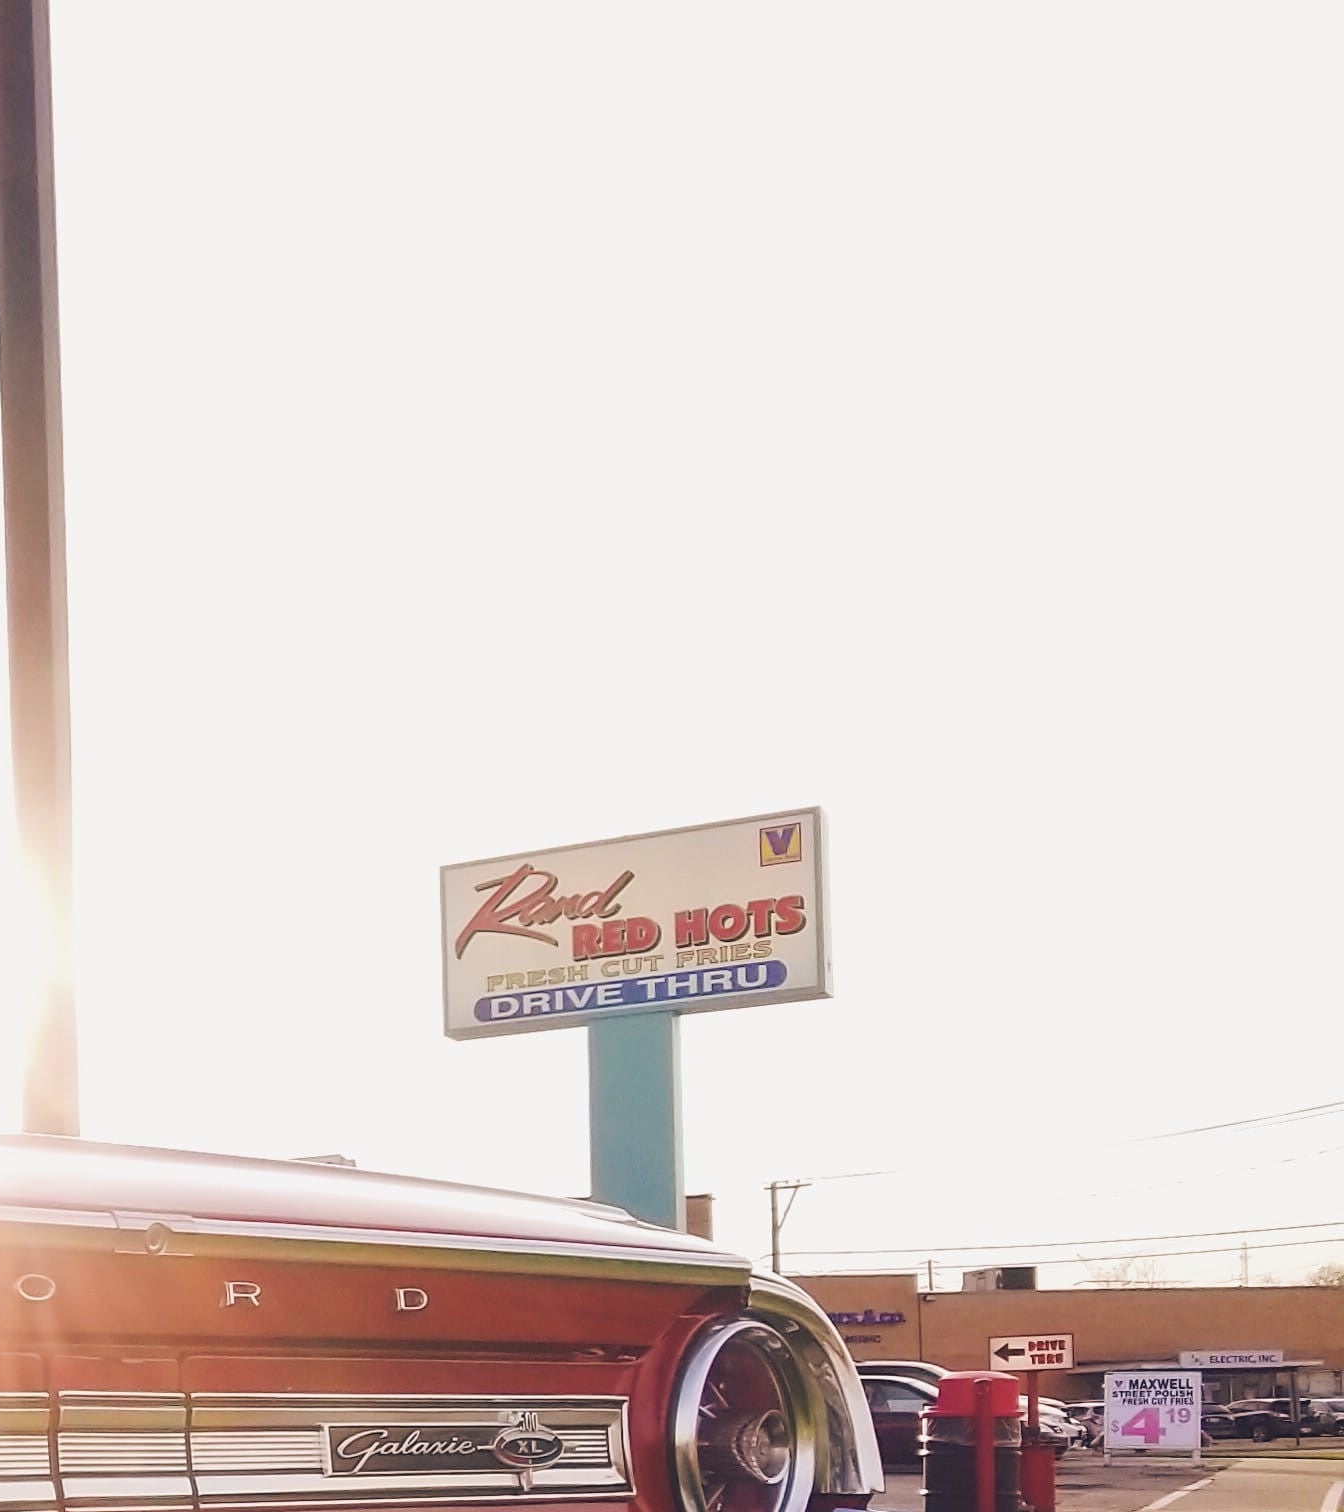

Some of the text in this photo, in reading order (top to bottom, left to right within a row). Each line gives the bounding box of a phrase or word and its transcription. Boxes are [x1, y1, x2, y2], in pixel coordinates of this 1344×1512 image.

[455, 863, 635, 960] Rand
[572, 896, 806, 961] RED HOTS
[487, 940, 773, 992] FRESH CUT FRIES
[490, 965, 768, 1019] DRIVE THRU
[1028, 1340, 1066, 1351] DRIVE
[1030, 1353, 1064, 1365] THRU
[1112, 1390, 1193, 1398] STREET POLISH
[1129, 1378, 1193, 1390] MAXWELL
[519, 1411, 539, 1432] 500
[337, 1429, 544, 1474] Galaxie XL
